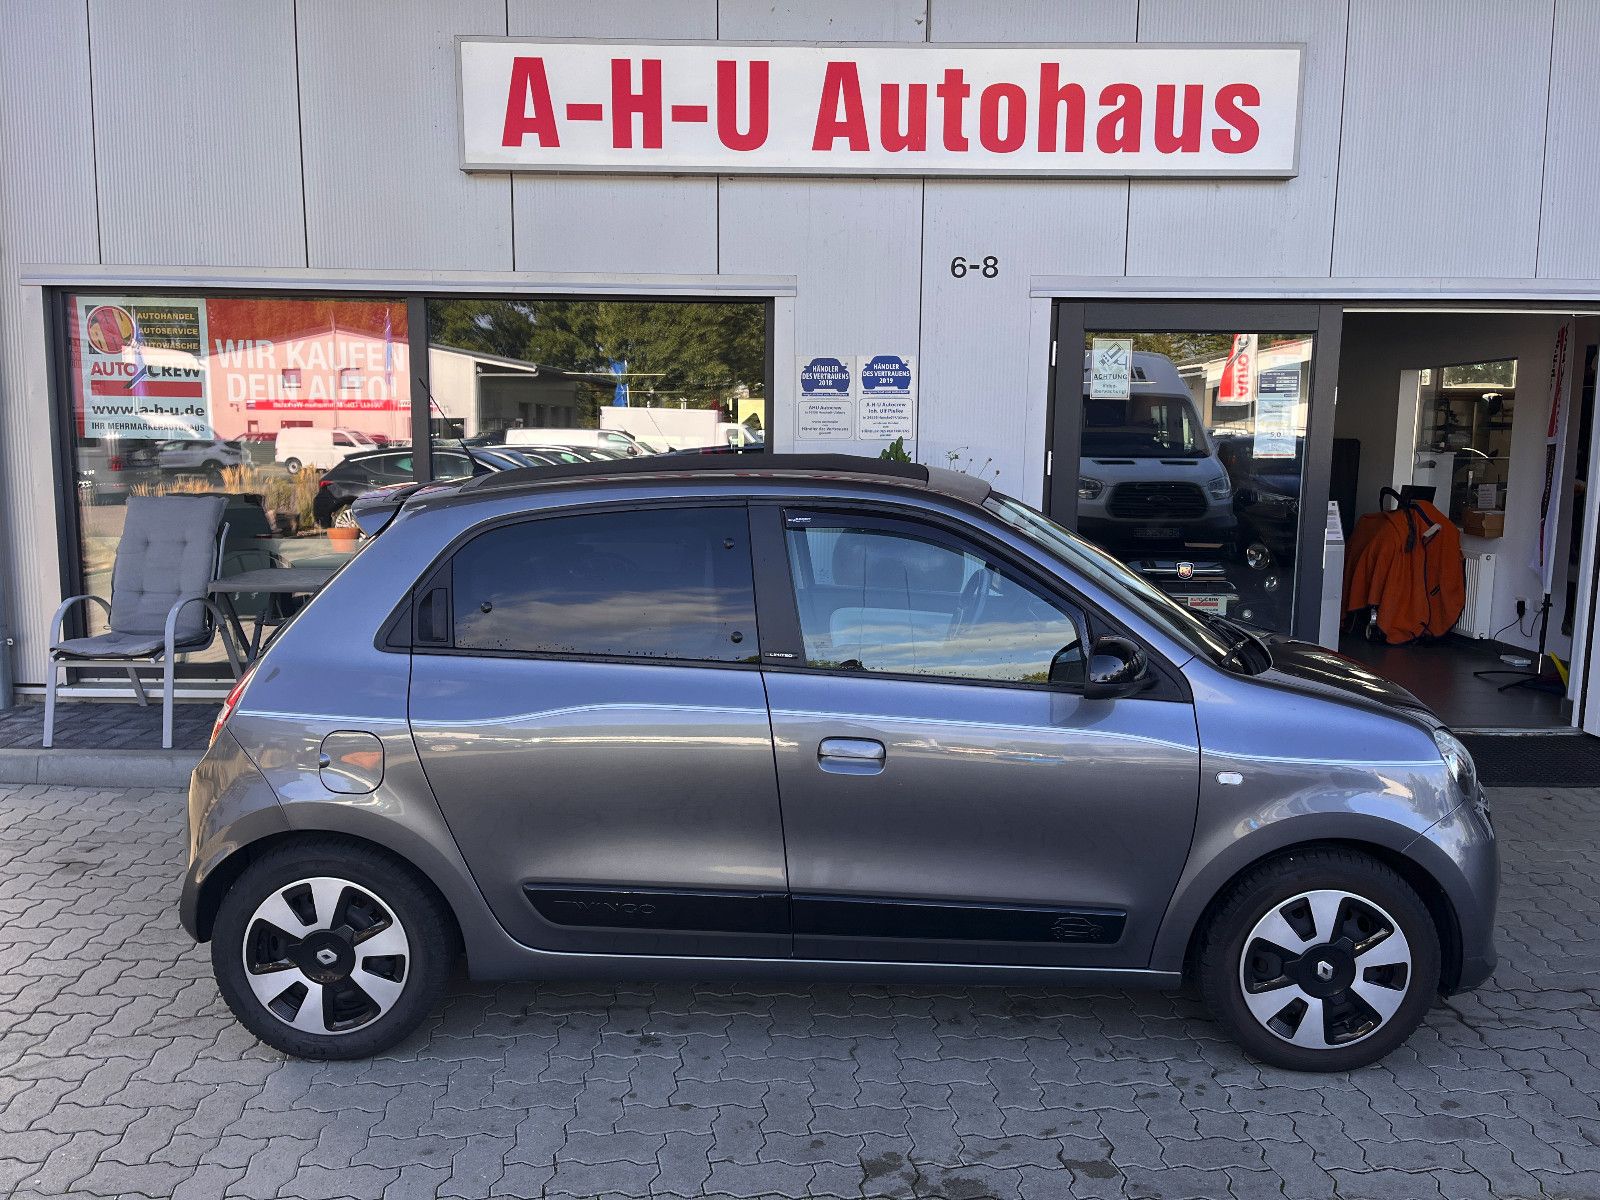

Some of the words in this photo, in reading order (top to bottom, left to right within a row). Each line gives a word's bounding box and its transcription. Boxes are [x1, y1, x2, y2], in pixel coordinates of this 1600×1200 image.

[502, 56, 770, 152] A-H-U
[811, 61, 1261, 155] Autohaus
[950, 256, 999, 280] 6-8
[137, 312, 195, 320] AUTOHANDEL
[138, 327, 199, 335] AUTOSERVICE
[215, 339, 276, 369] WIR
[288, 341, 405, 372] KAUFEN
[91, 362, 138, 377] AUTO
[227, 373, 299, 402] DEIN
[92, 404, 205, 417] www.a-h-u.de
[92, 422, 105, 430] IHR
